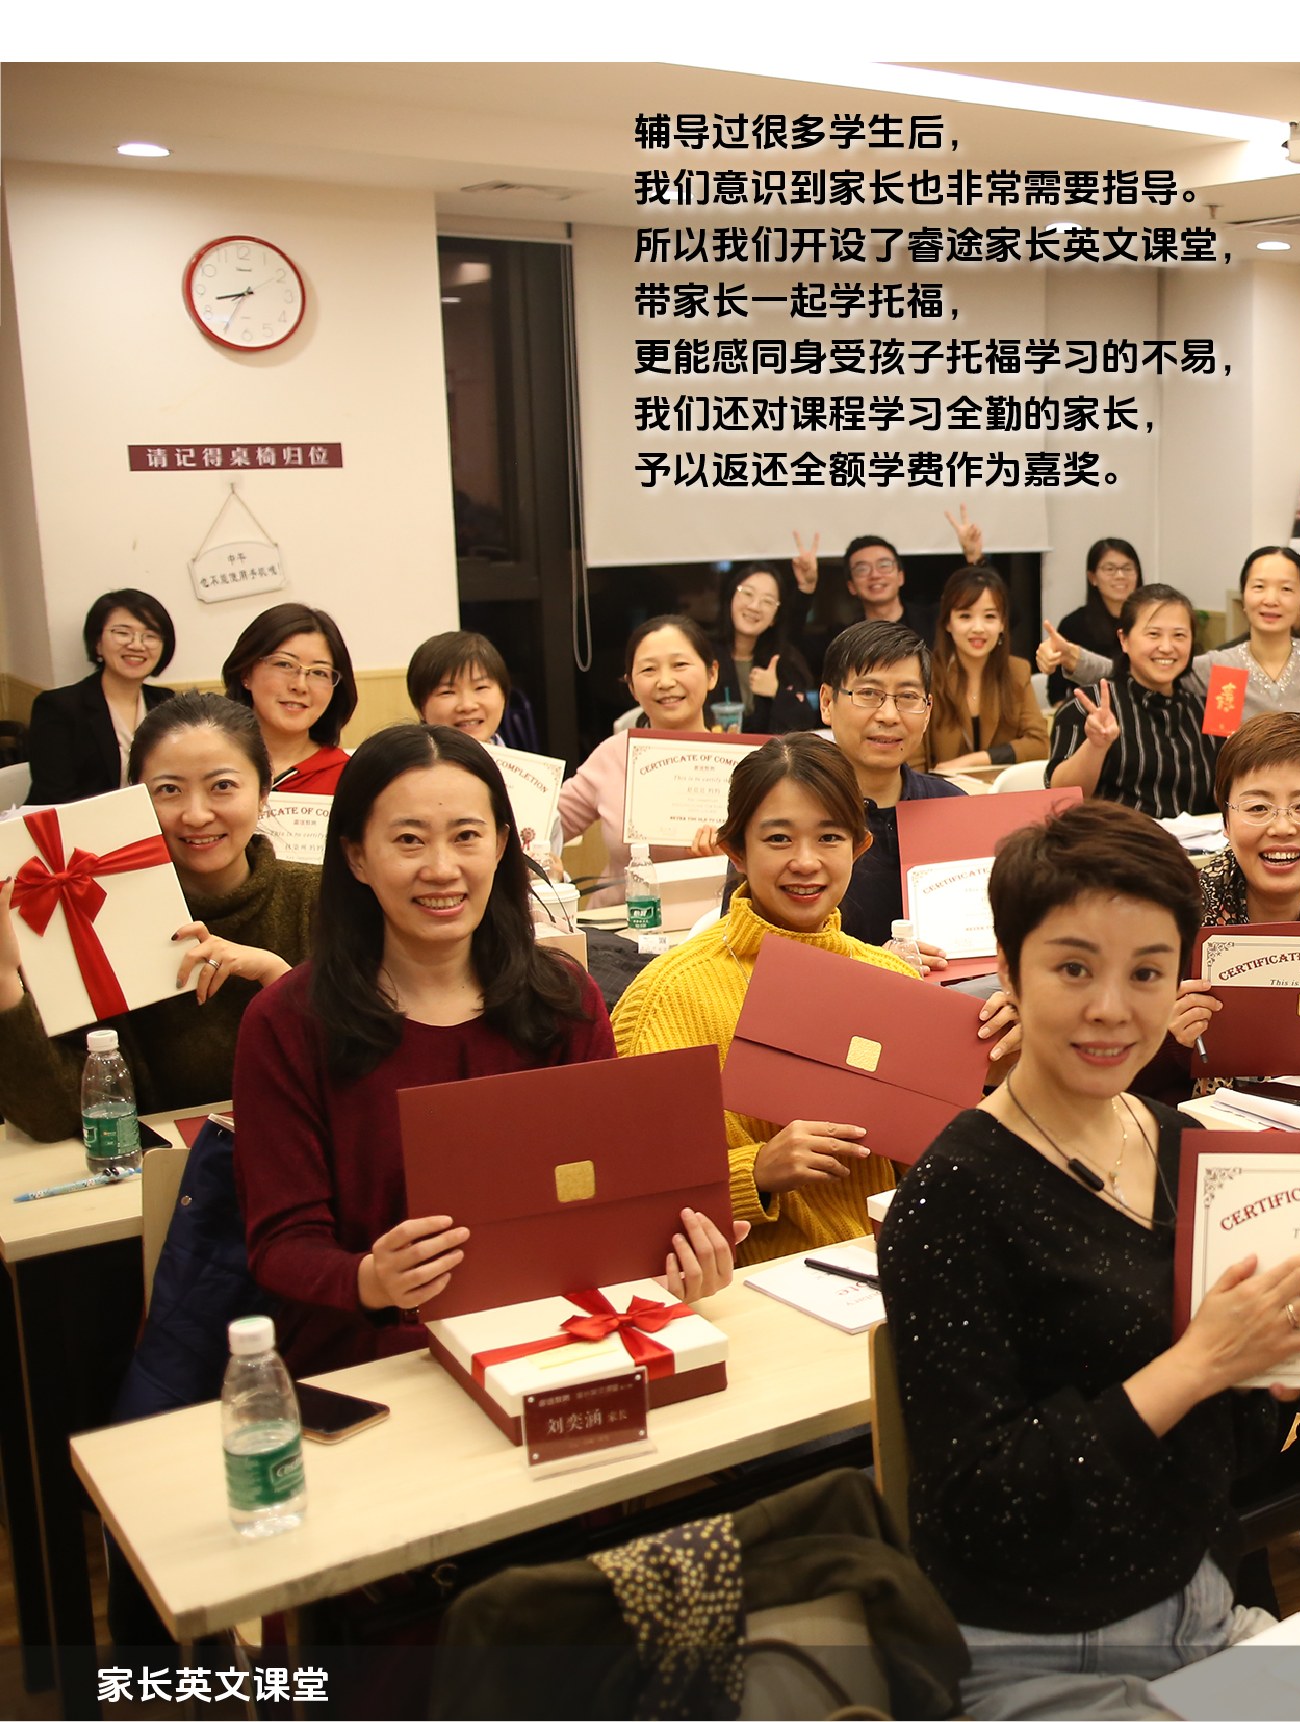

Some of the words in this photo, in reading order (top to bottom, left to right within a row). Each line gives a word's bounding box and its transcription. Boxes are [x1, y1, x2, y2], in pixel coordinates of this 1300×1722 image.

[146, 446, 330, 468] 请记得桌椅归位
[496, 759, 549, 793] COMPLETION
[640, 755, 698, 776] CERTIFICATE
[301, 807, 314, 815] OF
